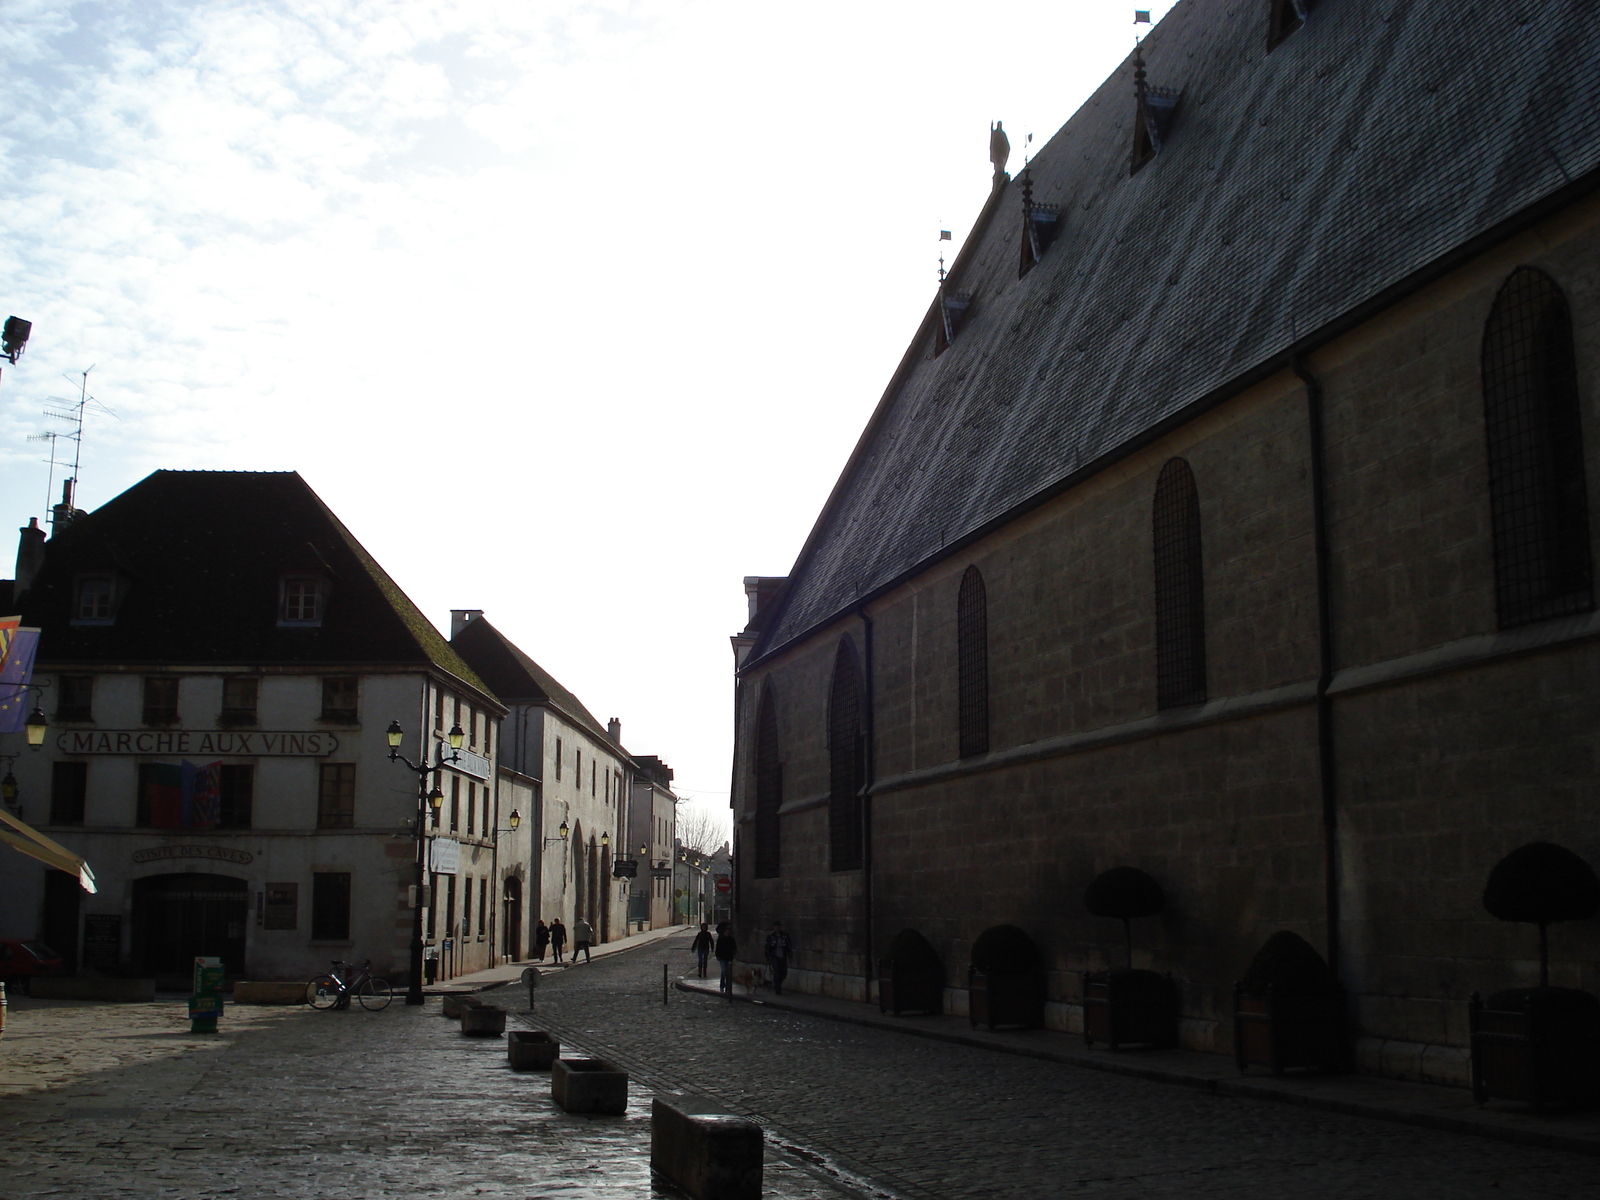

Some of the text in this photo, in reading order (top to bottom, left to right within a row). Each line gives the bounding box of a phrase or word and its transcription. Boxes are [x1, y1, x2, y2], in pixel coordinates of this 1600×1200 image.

[199, 734, 253, 753] AUX
[259, 734, 322, 754] VINS
[139, 847, 245, 861] VISITE DES CAVES
